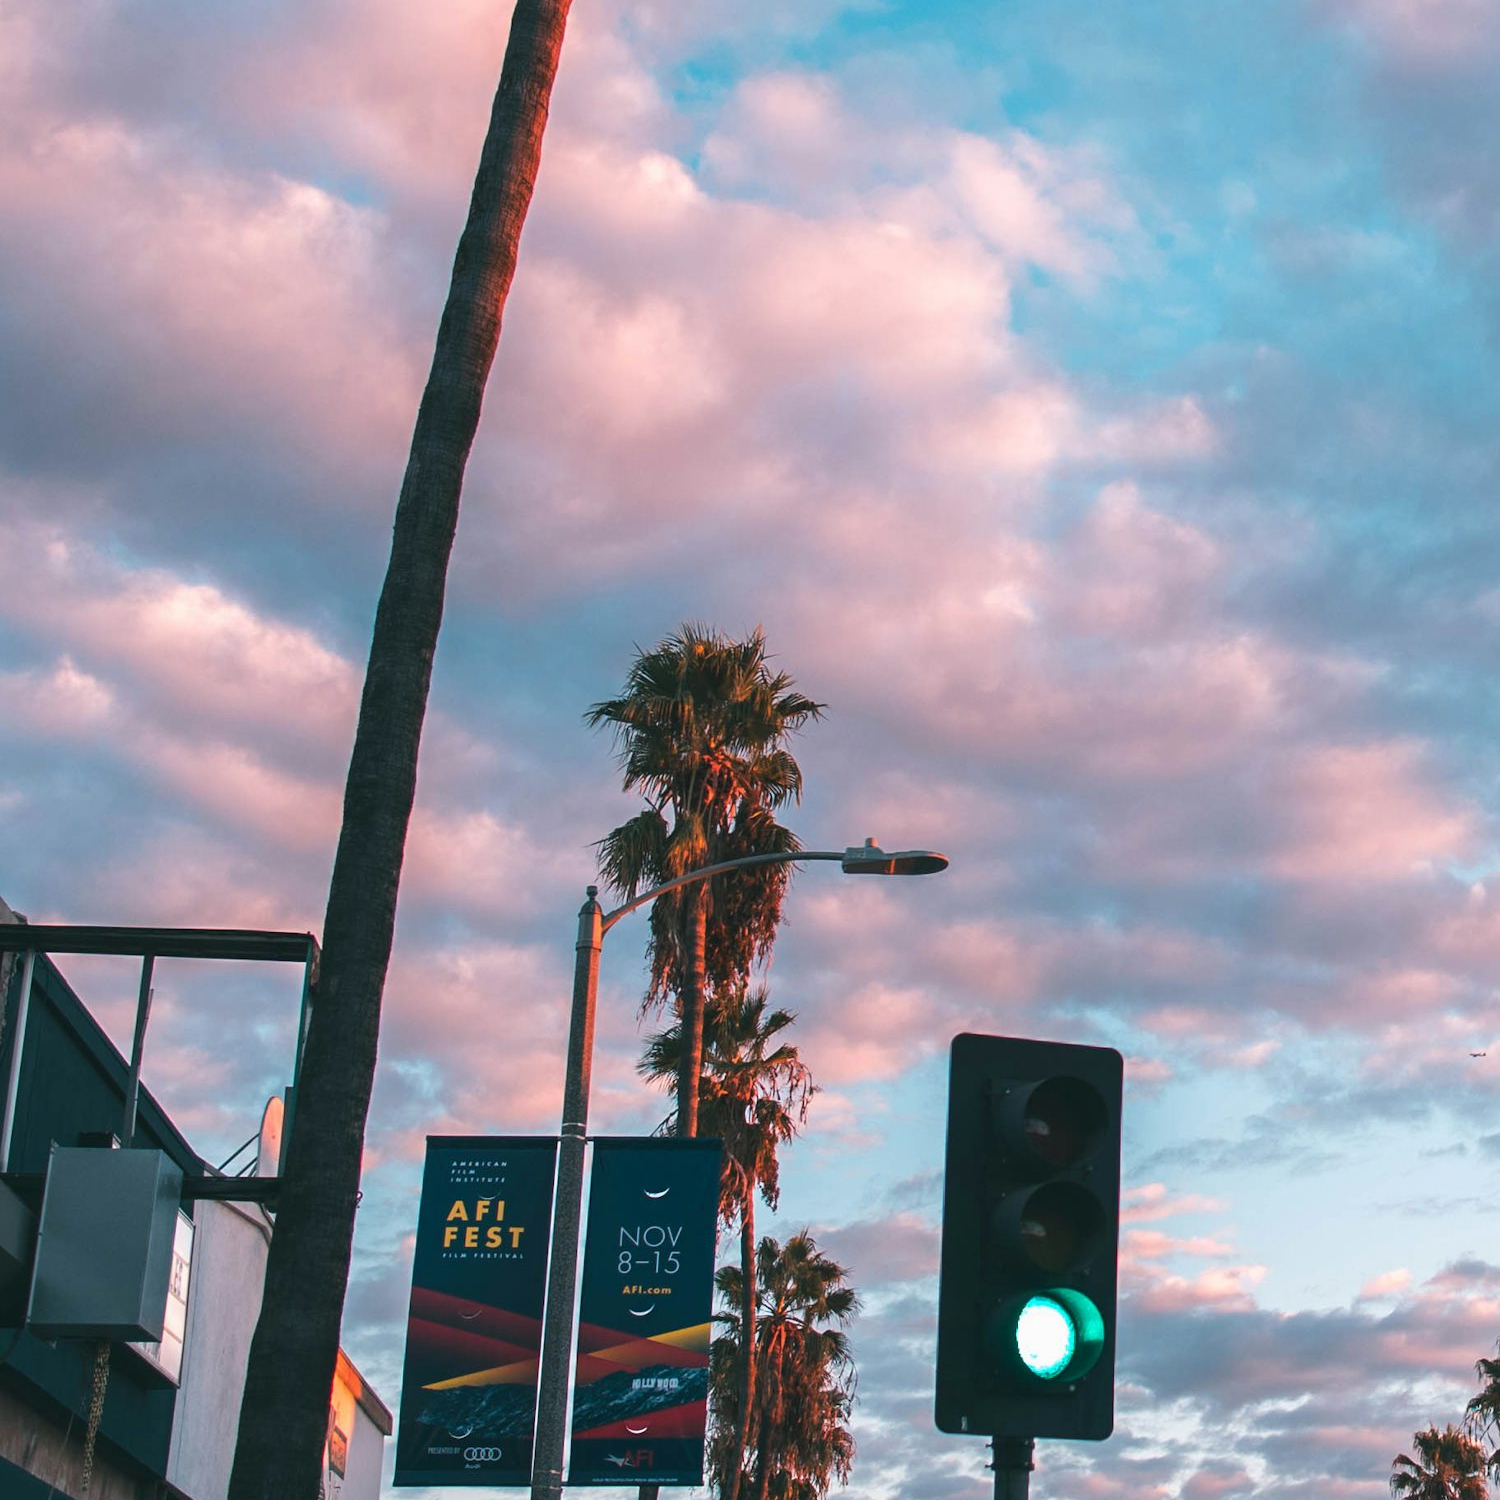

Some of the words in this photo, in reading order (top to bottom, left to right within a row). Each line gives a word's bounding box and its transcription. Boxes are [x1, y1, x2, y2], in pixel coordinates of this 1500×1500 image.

[446, 1200, 506, 1222] AFI
[442, 1226, 525, 1249] FEST
[618, 1226, 683, 1248] NOV
[474, 1252, 524, 1260] FESTIVAL
[622, 1284, 672, 1296] AFI.com
